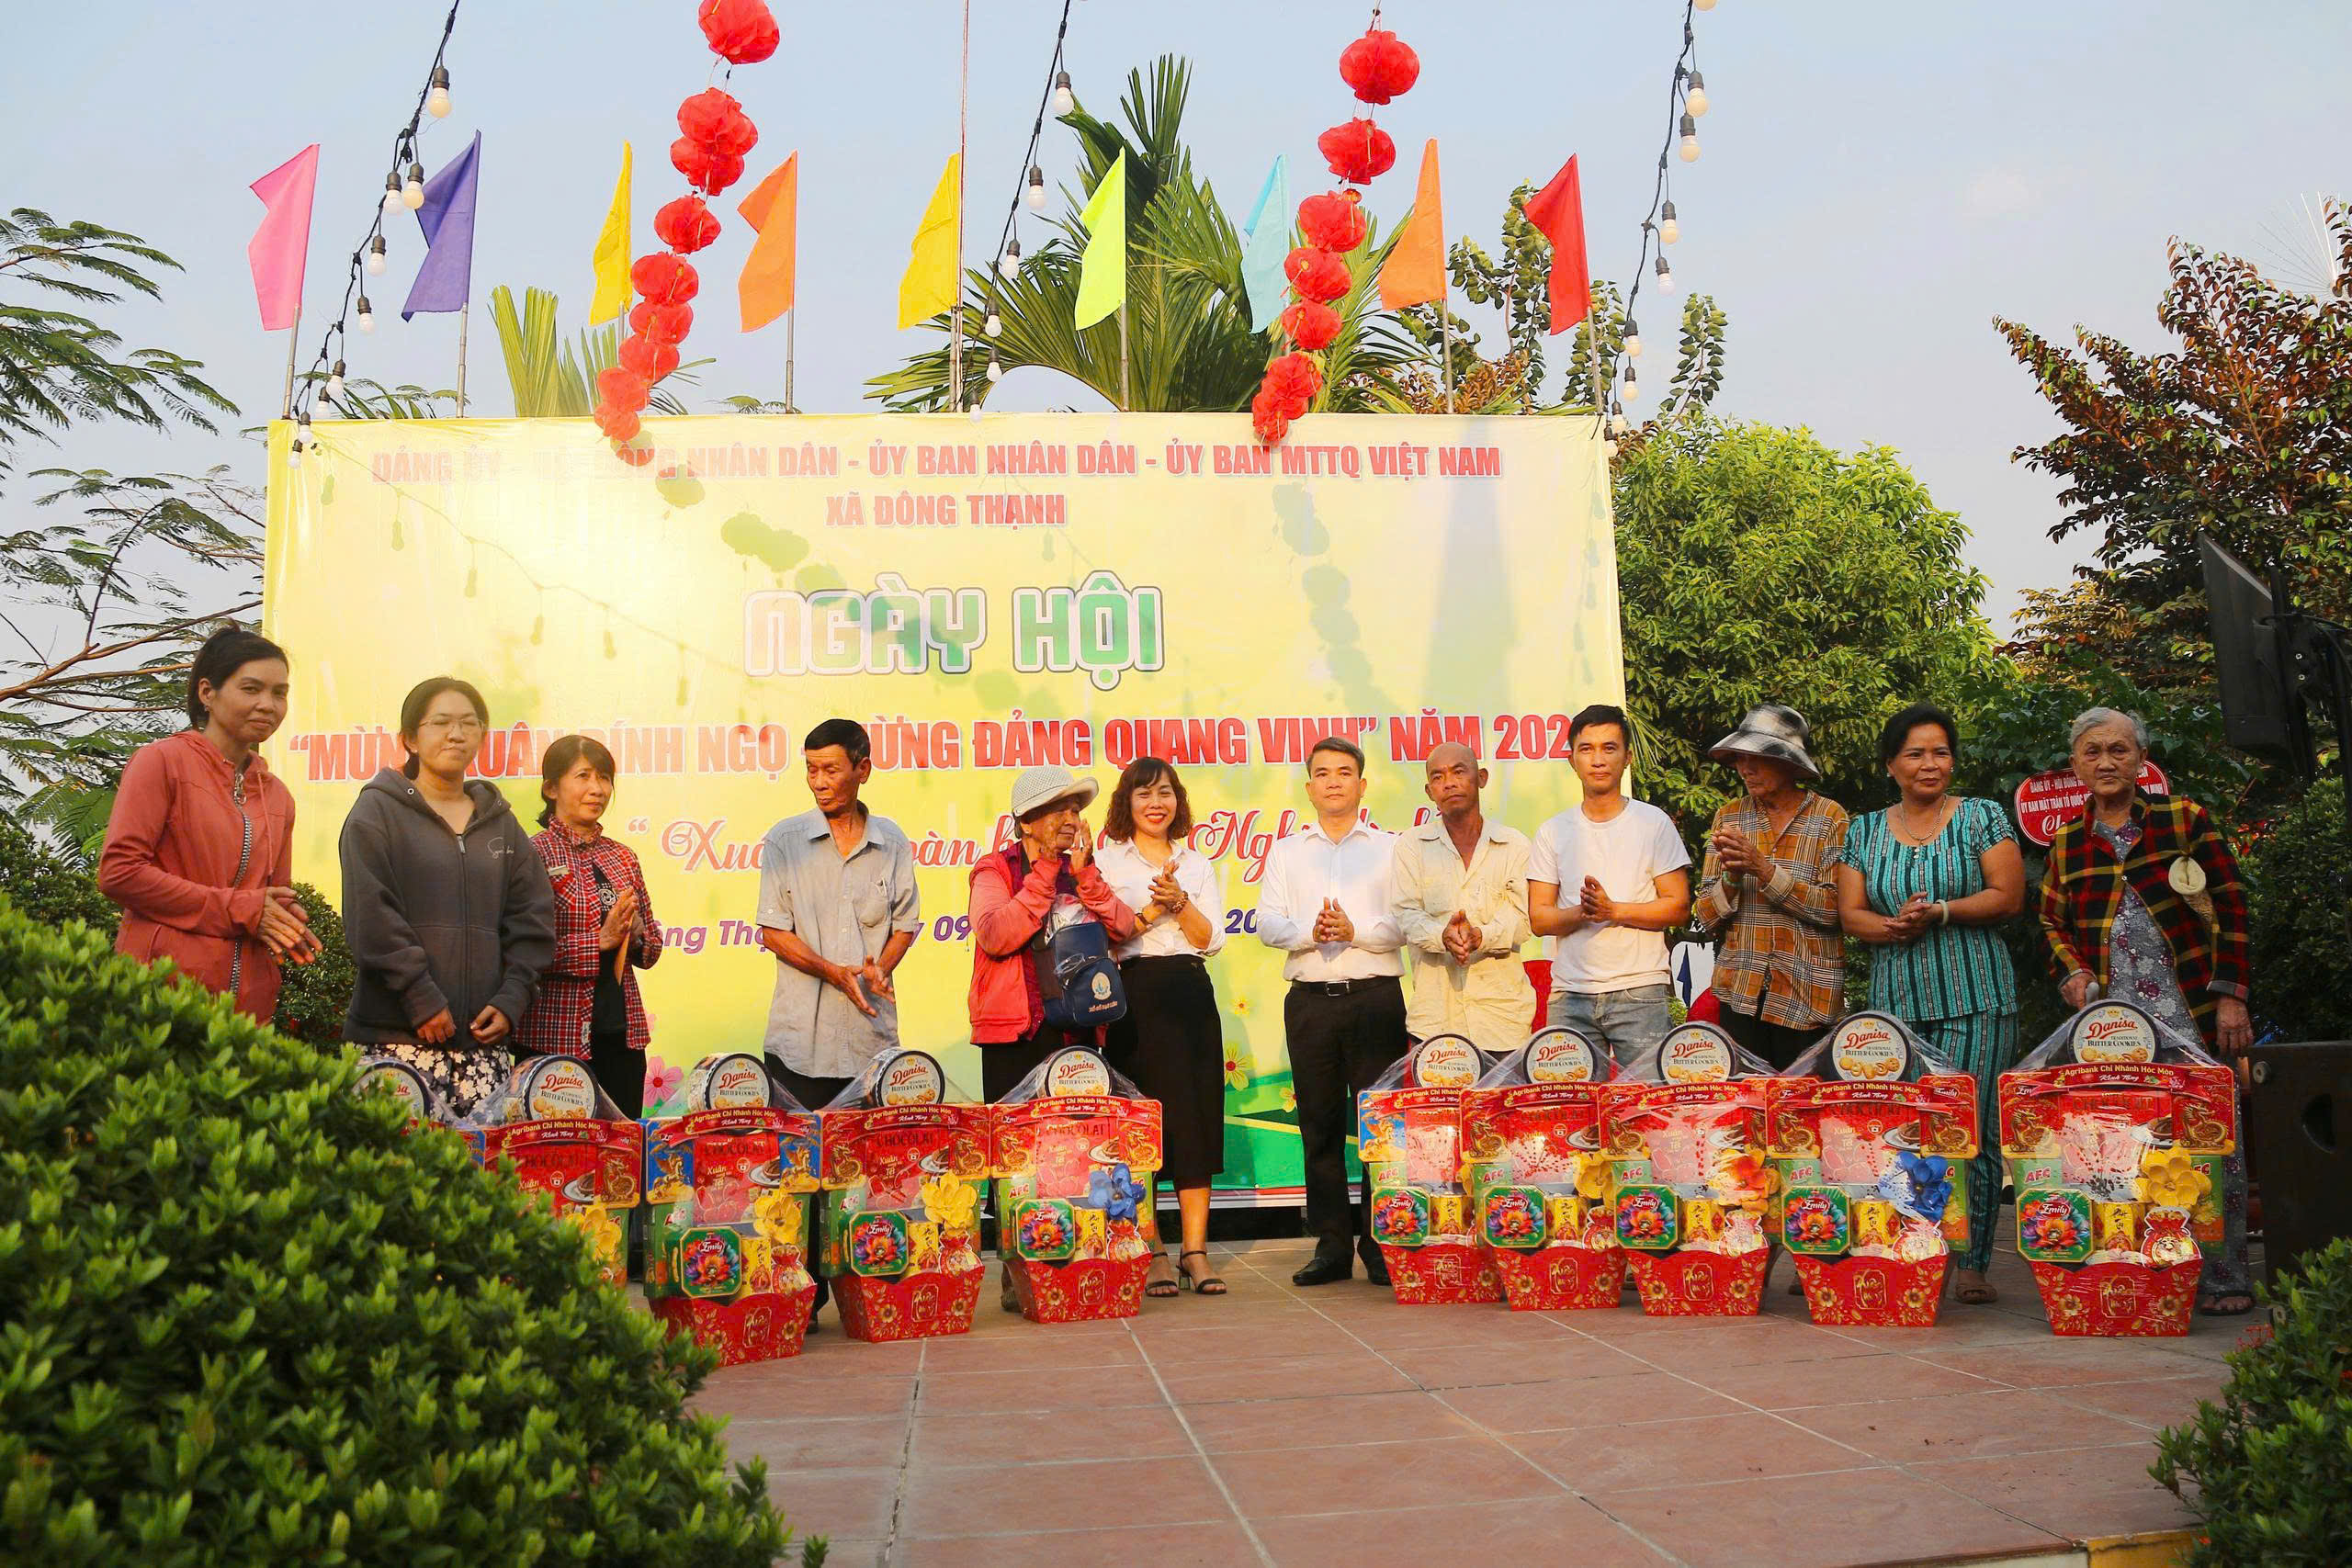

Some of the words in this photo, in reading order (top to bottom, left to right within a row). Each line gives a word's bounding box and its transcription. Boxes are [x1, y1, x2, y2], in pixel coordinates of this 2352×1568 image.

[687, 442, 768, 478] NHÂN
[778, 442, 838, 477] DÂN
[869, 439, 908, 477] ỦY
[918, 446, 978, 476] BAN
[987, 439, 1067, 475] NHÂN
[1077, 440, 1136, 475] DÂN
[1166, 438, 1204, 475] ỦY
[1213, 445, 1271, 475] BAN
[1281, 446, 1361, 479] MTTQ
[1368, 442, 1430, 481] VIỆT
[1439, 446, 1500, 476] NAM
[826, 491, 865, 526] XÃ
[874, 491, 957, 526] ĐÔNG
[967, 494, 1065, 530] THẠNH
[744, 572, 987, 676] NGÀY
[1012, 570, 1165, 691] HỘI
[697, 724, 788, 780] NGỌ
[972, 709, 1091, 768] ĐẢNG
[1104, 717, 1247, 771] QUANG
[1389, 708, 1482, 761] NĂM
[2085, 1018, 2138, 1039] Danisa
[1843, 1029, 1890, 1049] Danisa
[1536, 1041, 1578, 1061] Danisa
[1671, 1039, 1714, 1058] Danisa
[1426, 1047, 1468, 1064] Danisa
[1058, 1060, 1096, 1078] Danisa
[2065, 1066, 2098, 1077] Agribank
[718, 1069, 757, 1089] Danisa
[890, 1065, 927, 1086] Danisa
[539, 1074, 584, 1092] Danisa
[1513, 1088, 1540, 1097] Agribank
[1646, 1089, 1674, 1100] Agribank
[1822, 1085, 1851, 1094] Agribank
[1039, 1100, 1065, 1108] Agribank
[695, 1112, 721, 1123] Agribank
[873, 1109, 898, 1119] Agribank
[512, 1124, 541, 1135] Agribank
[1621, 1167, 1643, 1181] AFC
[1790, 1168, 1813, 1180] AFC
[2025, 1168, 2052, 1183] AFC
[1390, 1198, 1411, 1208] Emily
[1504, 1199, 1525, 1208] Emily
[1634, 1196, 1657, 1207] Emily
[1803, 1199, 1828, 1211] Emily
[2039, 1203, 2068, 1216] Emily
[1035, 1212, 1057, 1221] Emily
[869, 1224, 890, 1234] Emily
[701, 1241, 723, 1252] Emily
